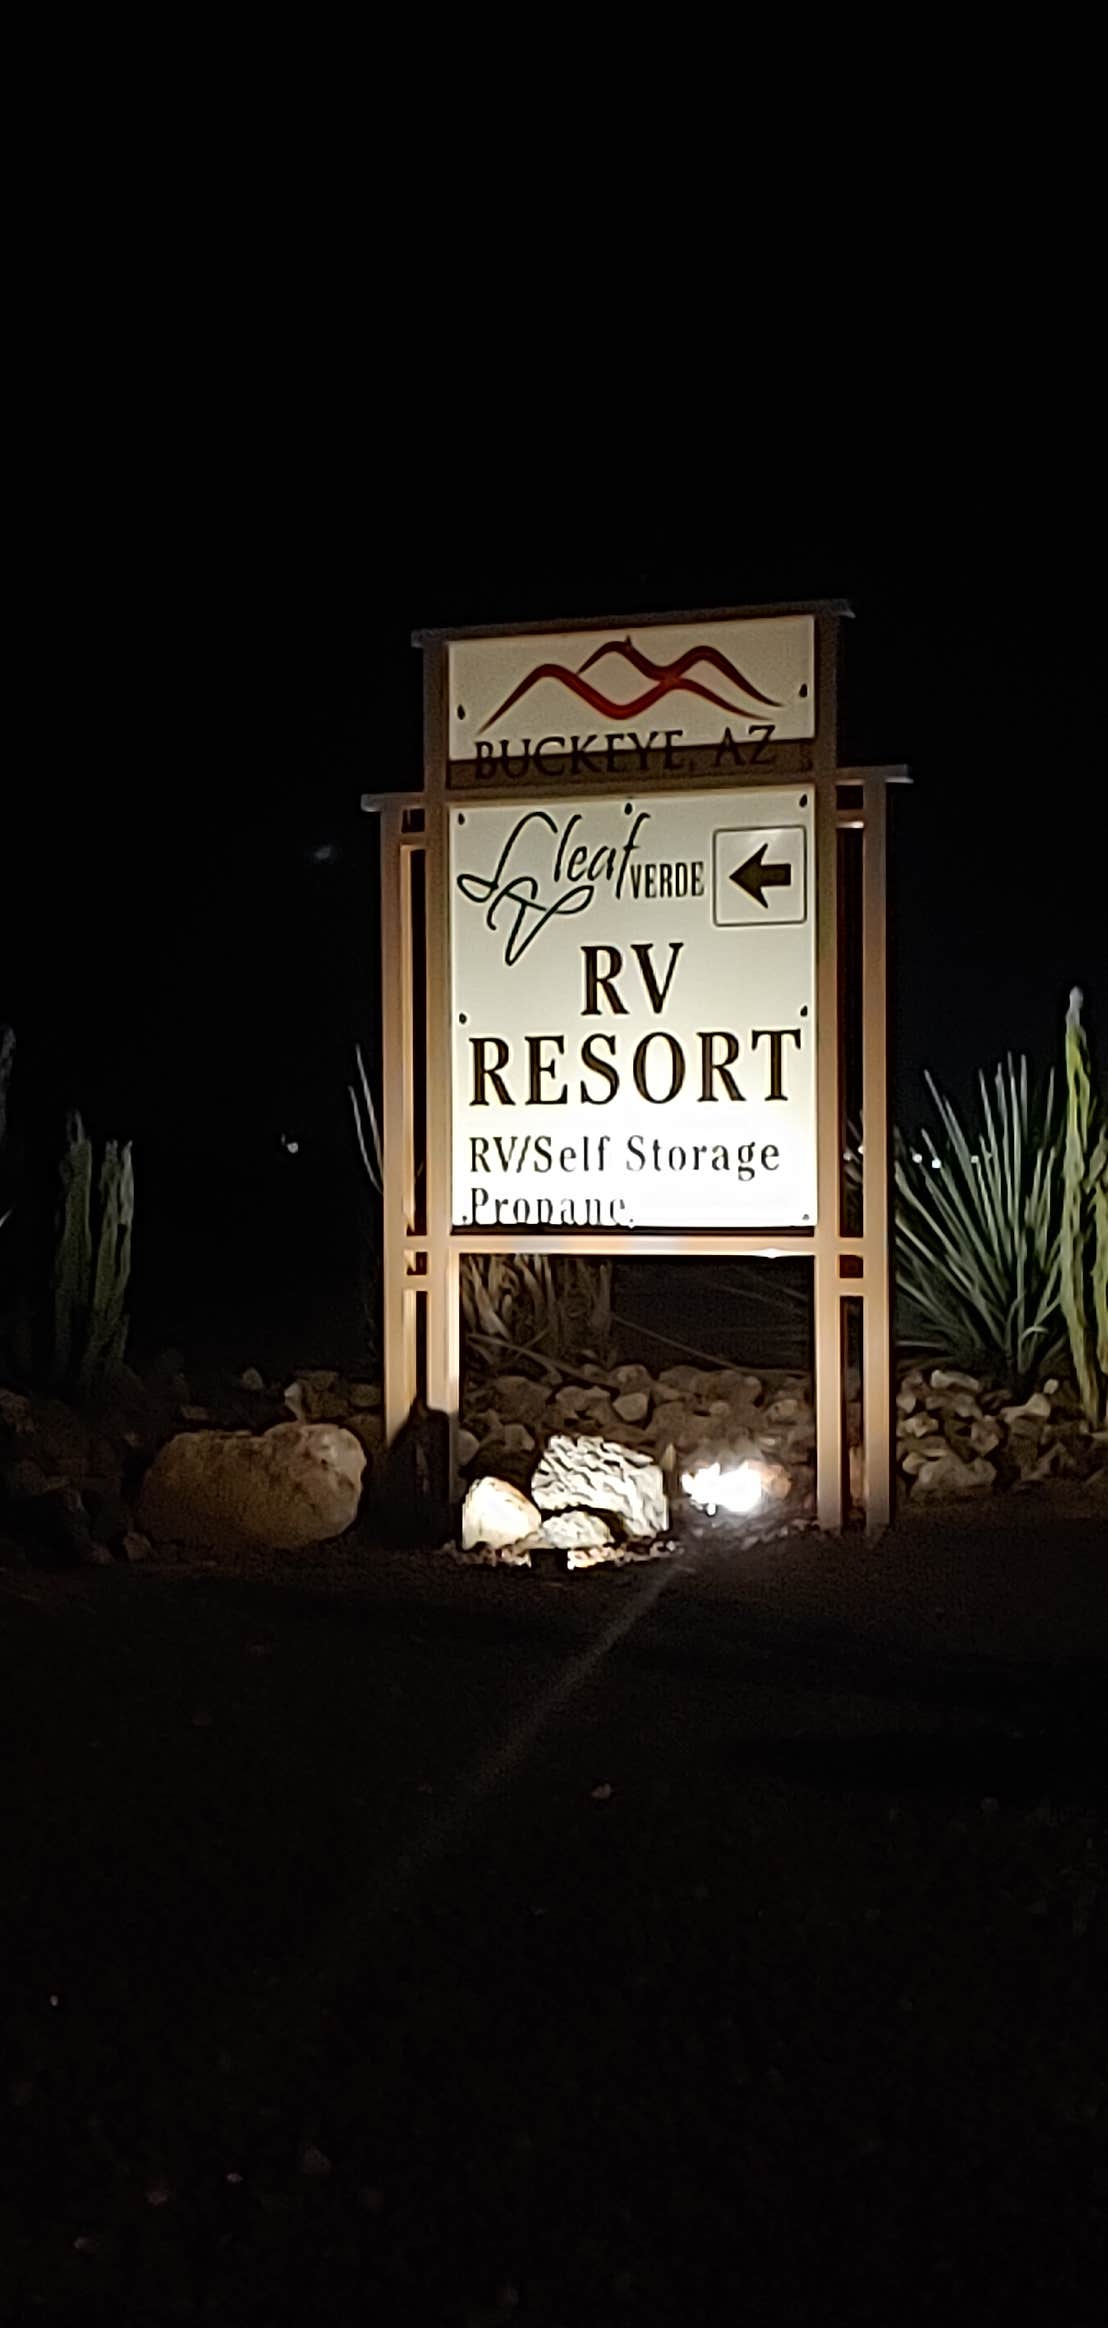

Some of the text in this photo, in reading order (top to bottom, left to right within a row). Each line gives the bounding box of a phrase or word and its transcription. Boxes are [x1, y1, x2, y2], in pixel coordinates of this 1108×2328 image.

[714, 725, 776, 767] AZ
[631, 860, 705, 899] VERDE
[580, 941, 685, 1016] RV
[468, 1028, 802, 1107] RESORT
[468, 1134, 781, 1182] RV/Self Storage
